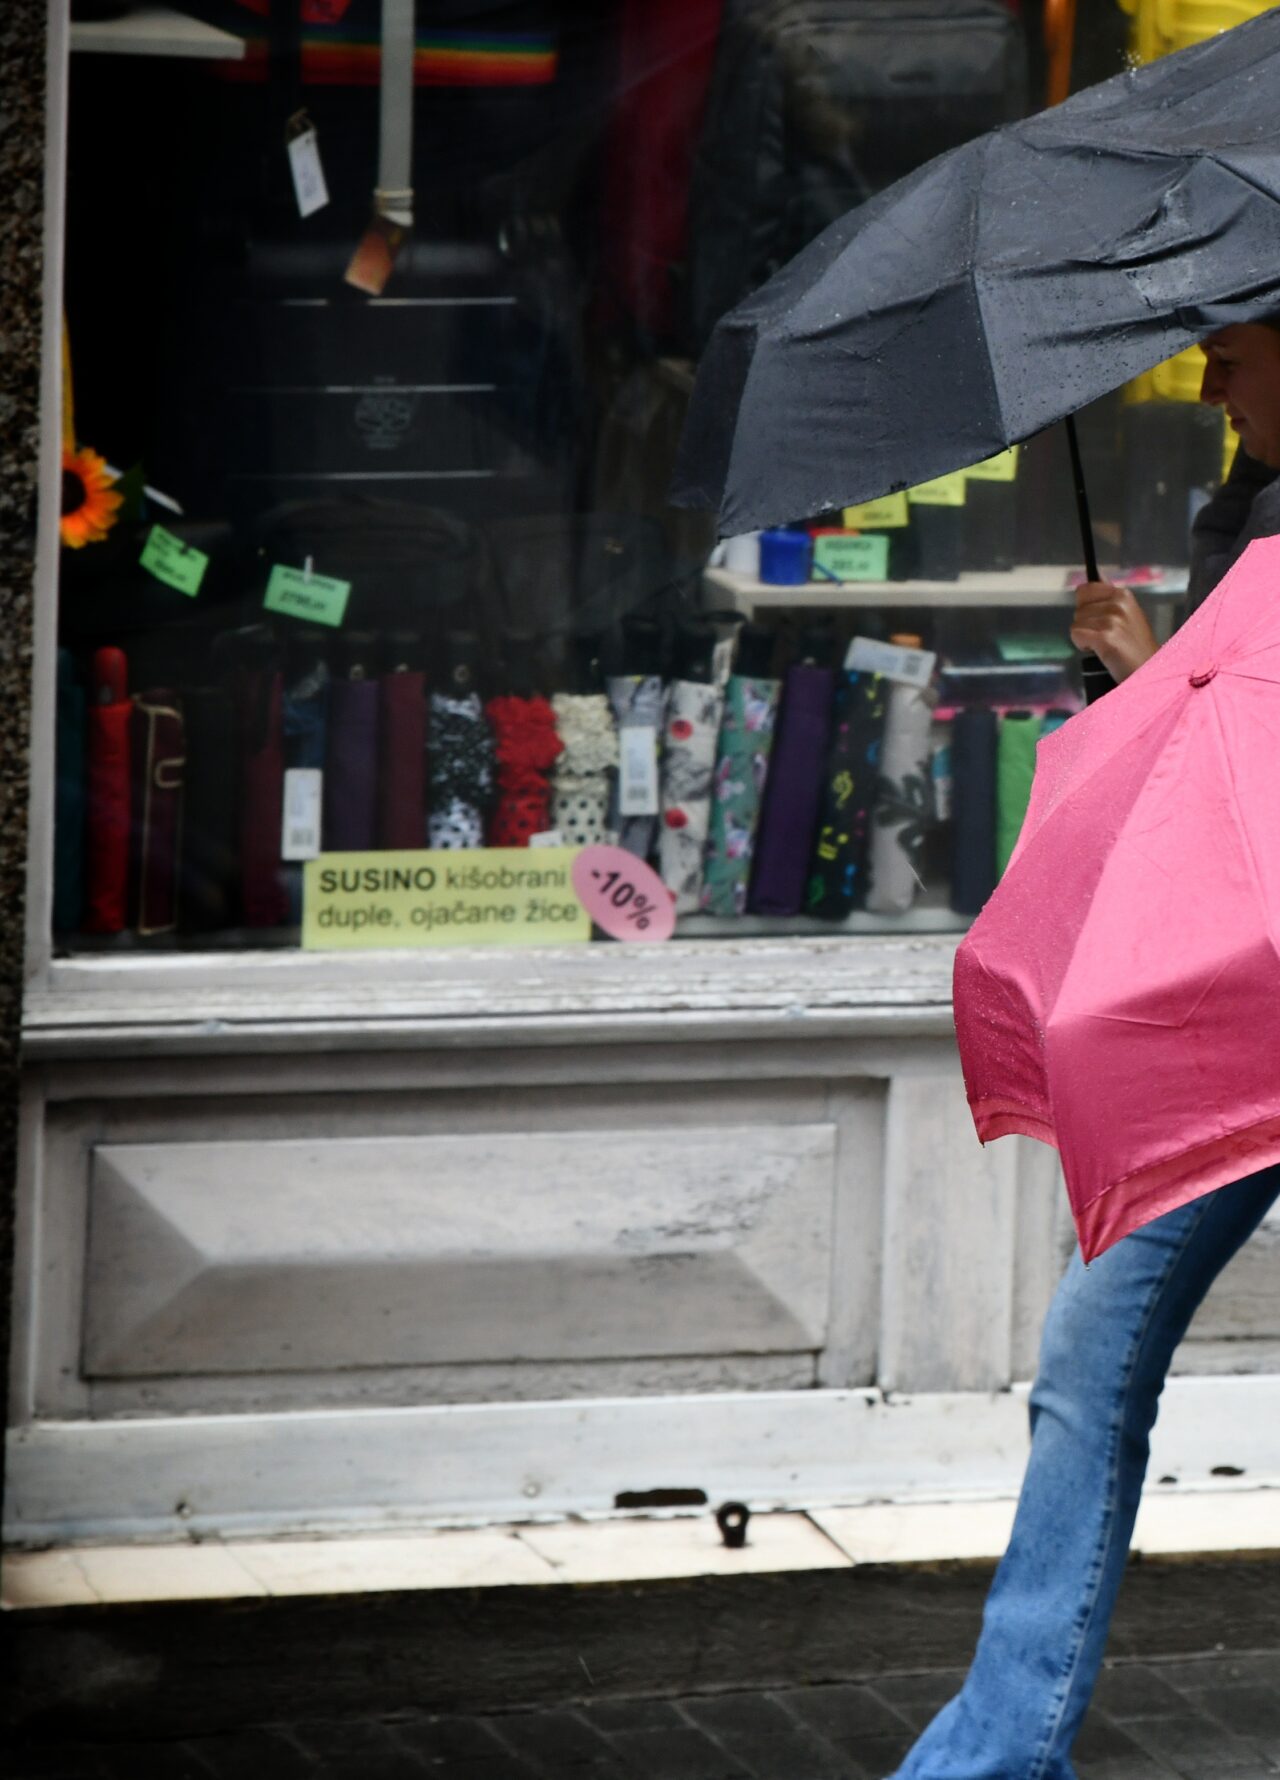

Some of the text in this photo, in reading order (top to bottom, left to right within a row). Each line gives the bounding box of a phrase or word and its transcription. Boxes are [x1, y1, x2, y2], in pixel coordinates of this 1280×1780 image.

[319, 864, 566, 894] SUSINO kišobrani
[317, 899, 579, 932] duple, ojačane žice
[591, 869, 657, 930] -10%
